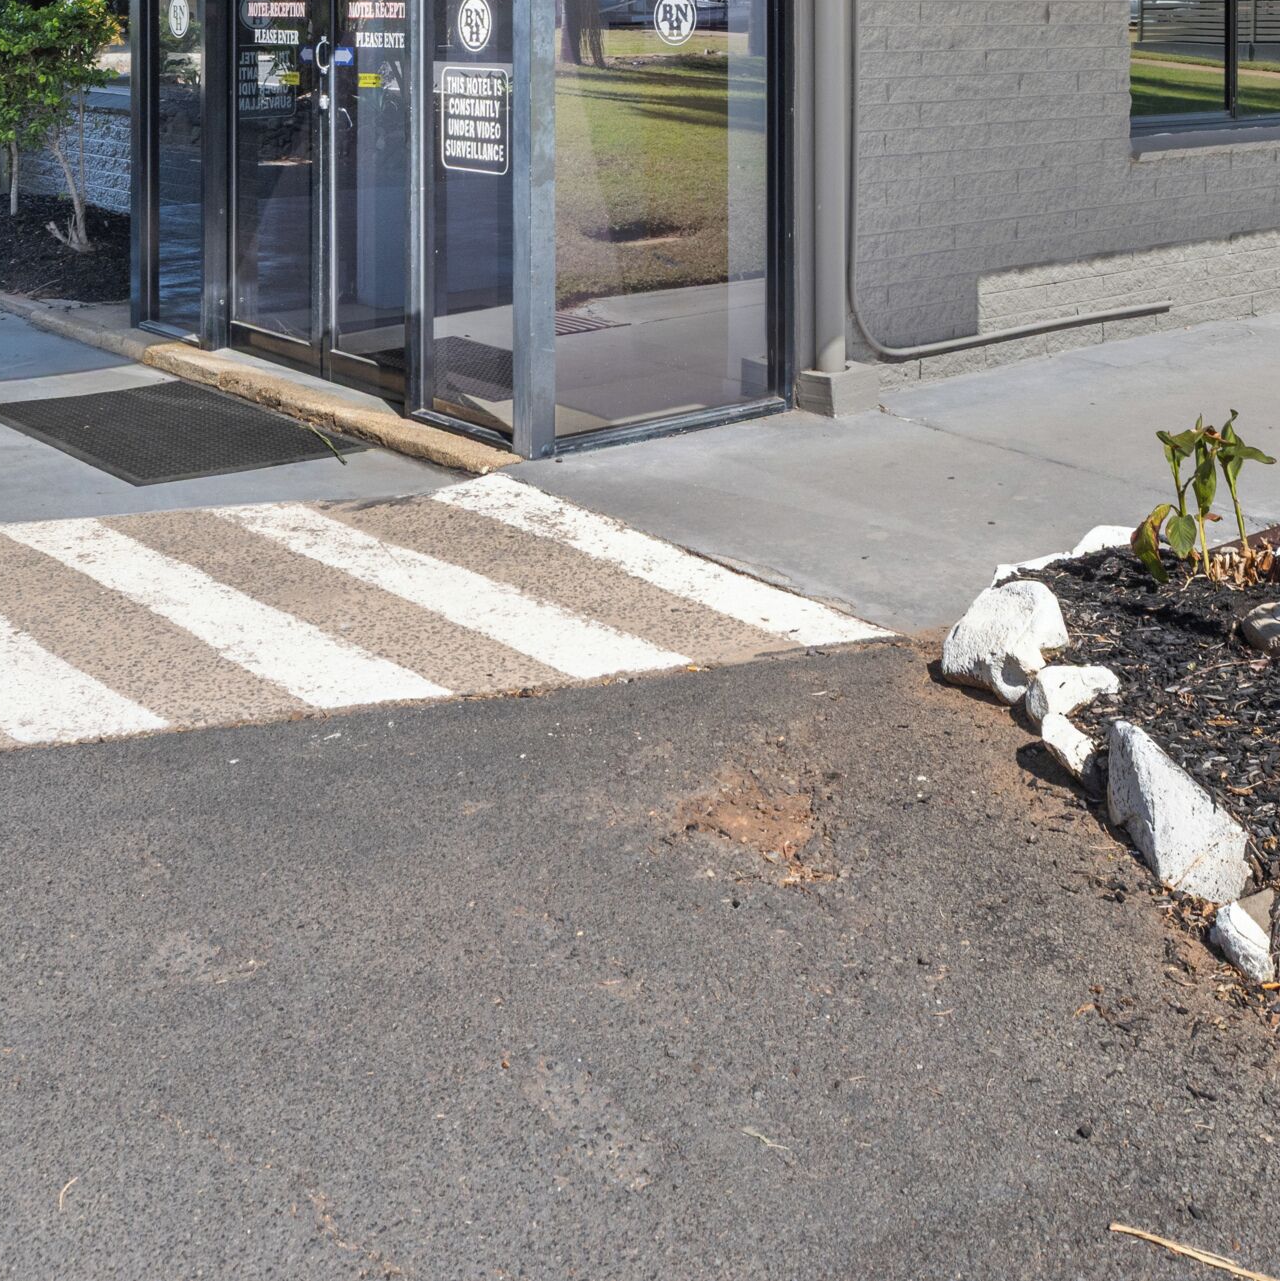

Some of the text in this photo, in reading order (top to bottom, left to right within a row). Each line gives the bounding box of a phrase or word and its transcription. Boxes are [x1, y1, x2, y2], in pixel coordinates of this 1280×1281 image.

[270, 2, 306, 17] RECEPTION
[348, 2, 405, 18] MOTEL RECEPTI
[254, 29, 299, 44] PLEASE ENTER
[356, 32, 405, 48] PLEASE ENTE
[447, 77, 502, 96] THIS HOTEL IS
[449, 98, 500, 118] CONSTANTLY
[448, 119, 500, 139] UNDER VIDEO
[446, 139, 504, 162] SURVEILLANCE
